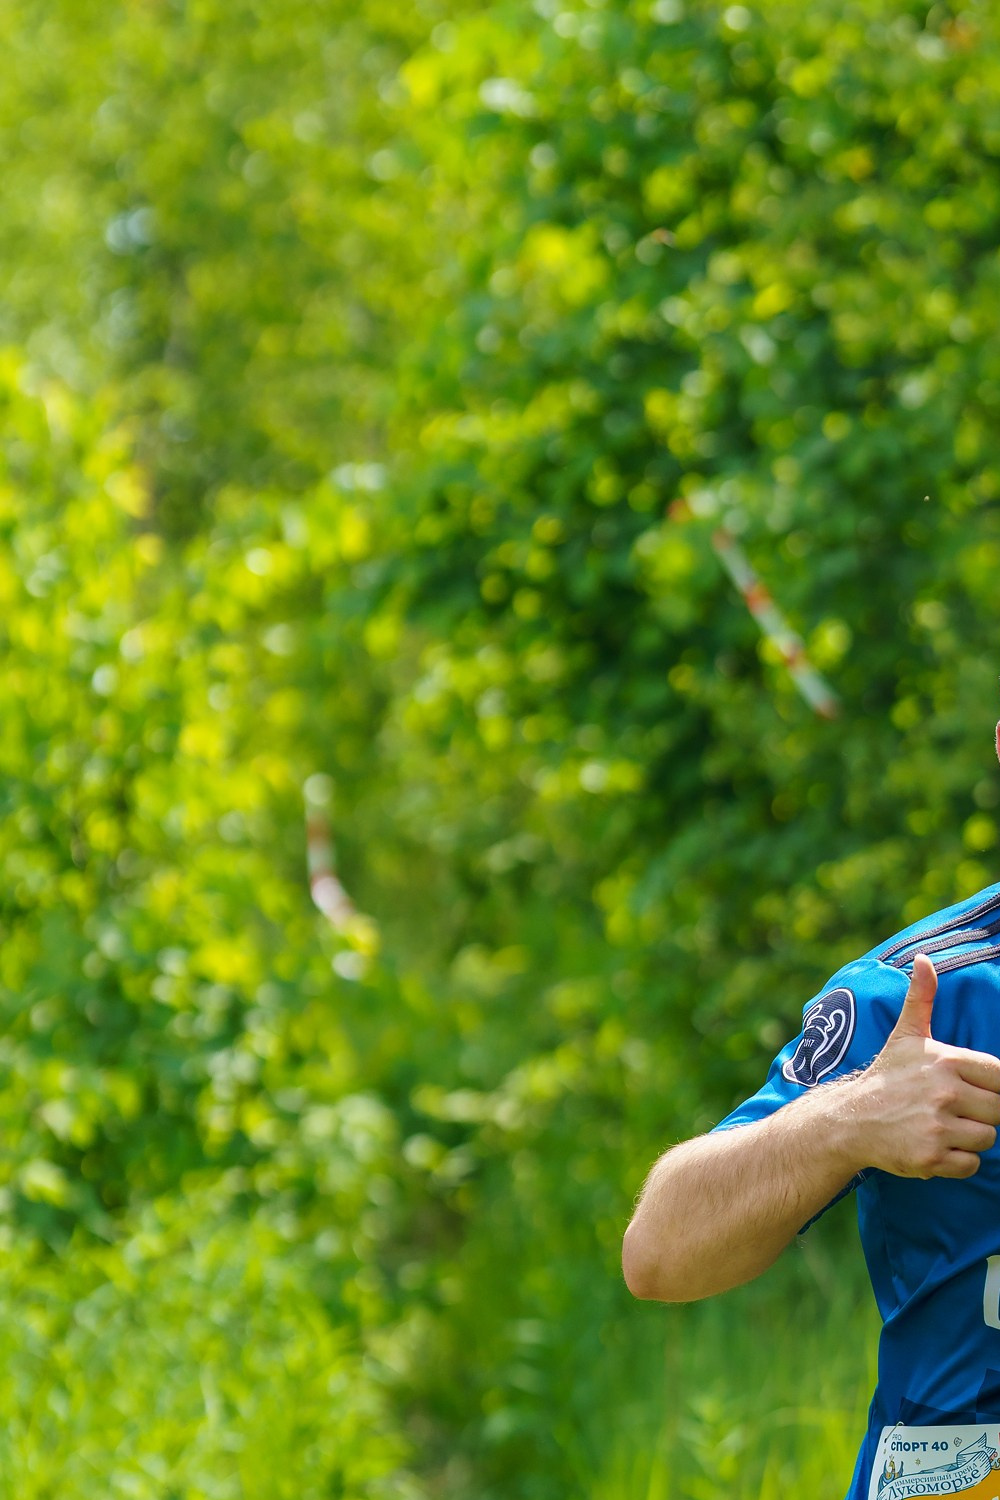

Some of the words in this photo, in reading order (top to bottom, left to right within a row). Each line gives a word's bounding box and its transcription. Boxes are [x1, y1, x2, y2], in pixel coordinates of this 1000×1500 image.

[891, 1441, 928, 1452] СПОРТ
[931, 1441, 949, 1451] 40
[894, 1472, 952, 1488] иммерсивный
[953, 1462, 978, 1479] трейл
